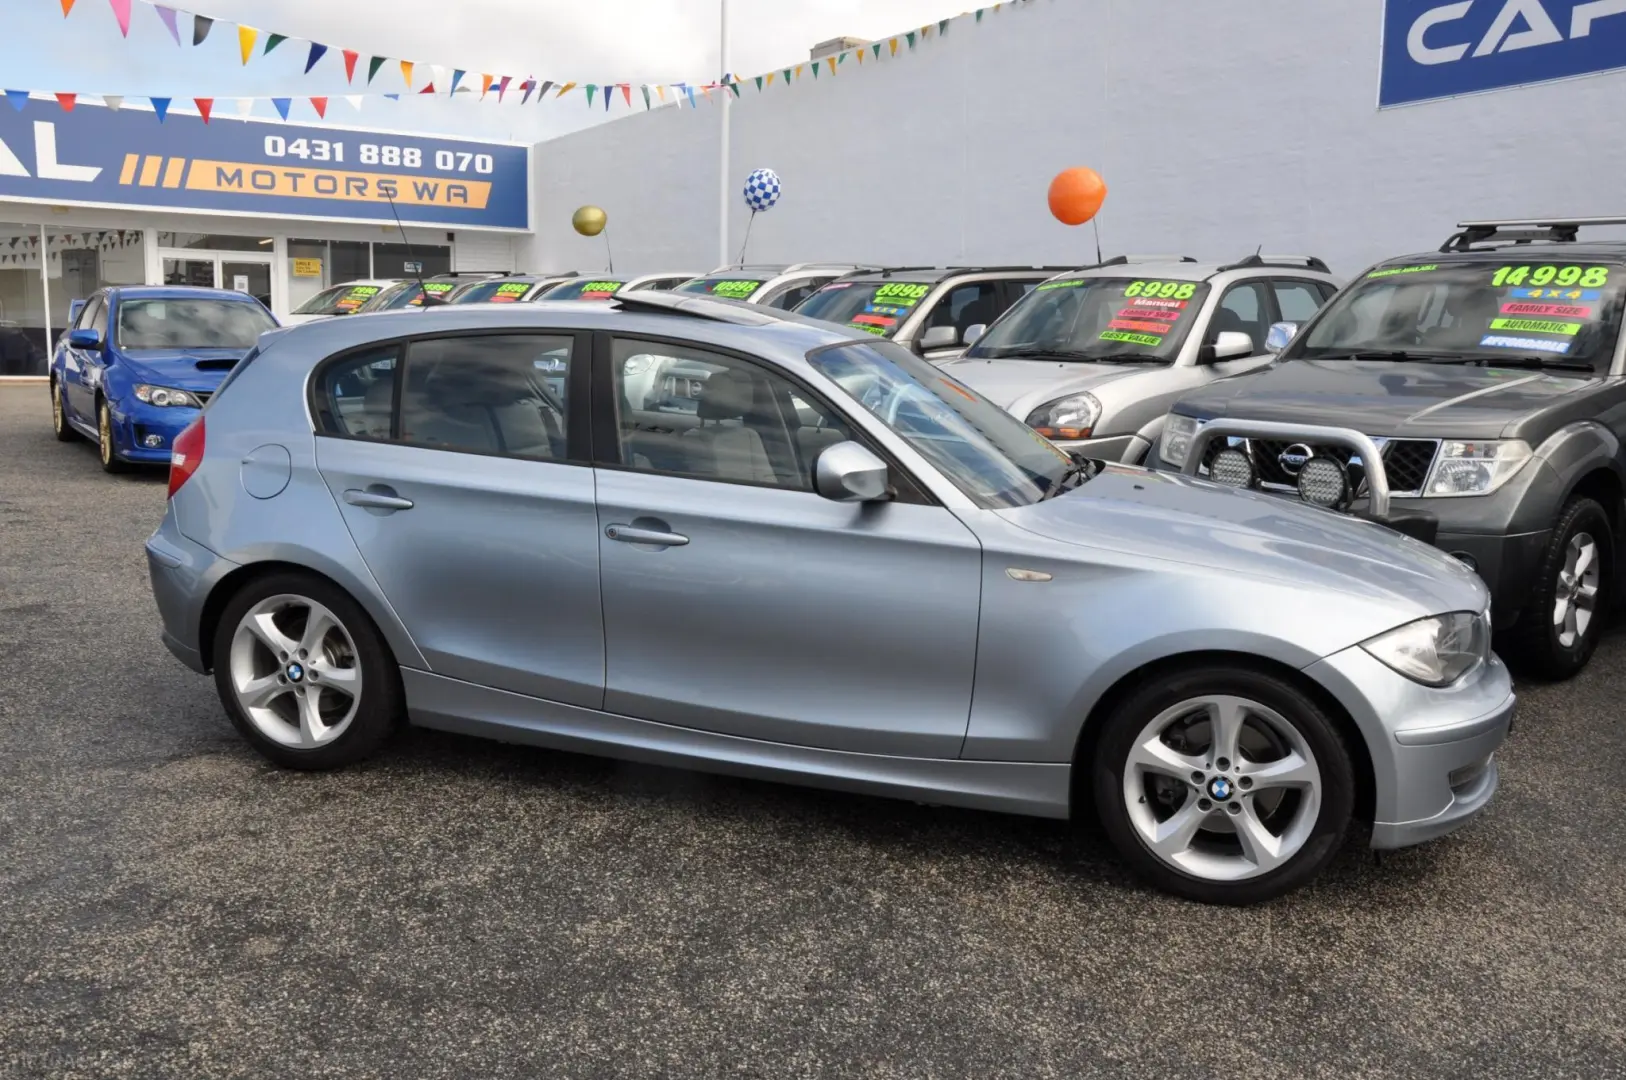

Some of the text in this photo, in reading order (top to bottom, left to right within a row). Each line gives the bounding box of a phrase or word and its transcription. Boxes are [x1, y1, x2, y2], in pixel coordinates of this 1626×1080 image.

[264, 135, 494, 174] 0431 888 070
[215, 166, 468, 204] MOTORS WA
[1491, 265, 1609, 288] 14998
[875, 283, 929, 298] 8998
[1124, 281, 1197, 300] 6998
[1133, 298, 1180, 308] Manual
[1507, 303, 1584, 315] FAMILY SIZE
[1501, 318, 1569, 333] AUTOMATIC
[1103, 331, 1160, 344] BEST VALUE
